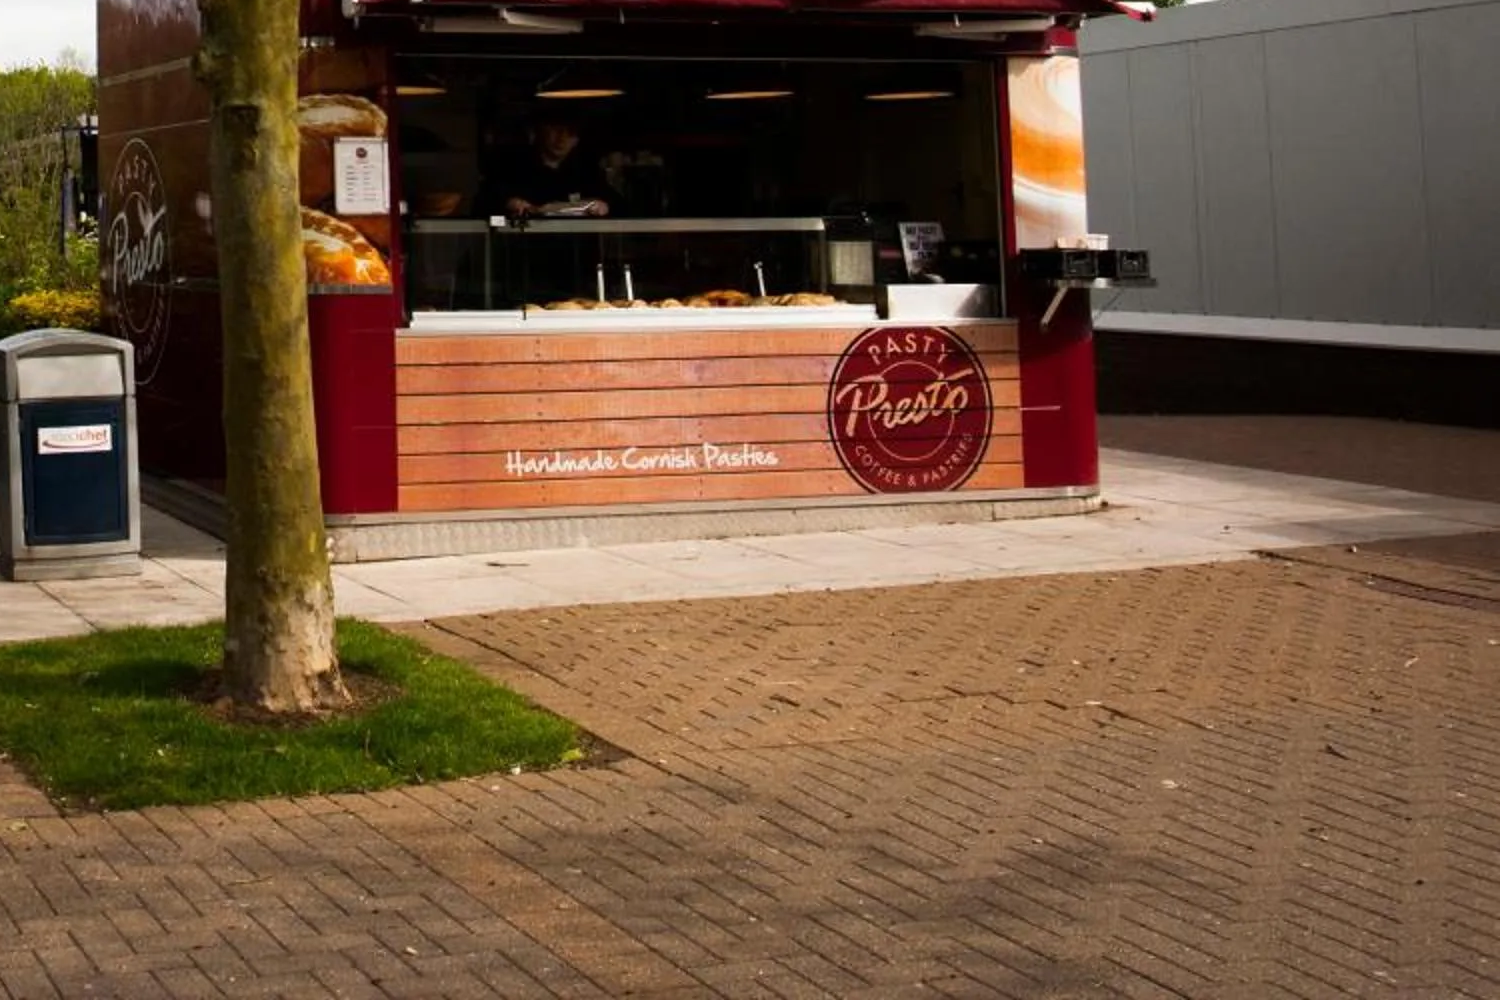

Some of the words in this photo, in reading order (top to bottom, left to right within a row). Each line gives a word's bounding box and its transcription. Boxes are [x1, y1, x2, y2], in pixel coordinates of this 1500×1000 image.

[107, 199, 167, 295] Presto
[868, 333, 952, 366] PASTY
[836, 368, 974, 437] Presto
[506, 449, 619, 476] Handmade
[622, 446, 697, 470] Cornish
[703, 442, 779, 470] Pasties
[855, 445, 901, 485] COFFEE
[907, 474, 917, 487] &
[923, 433, 973, 484] PASTRIES
